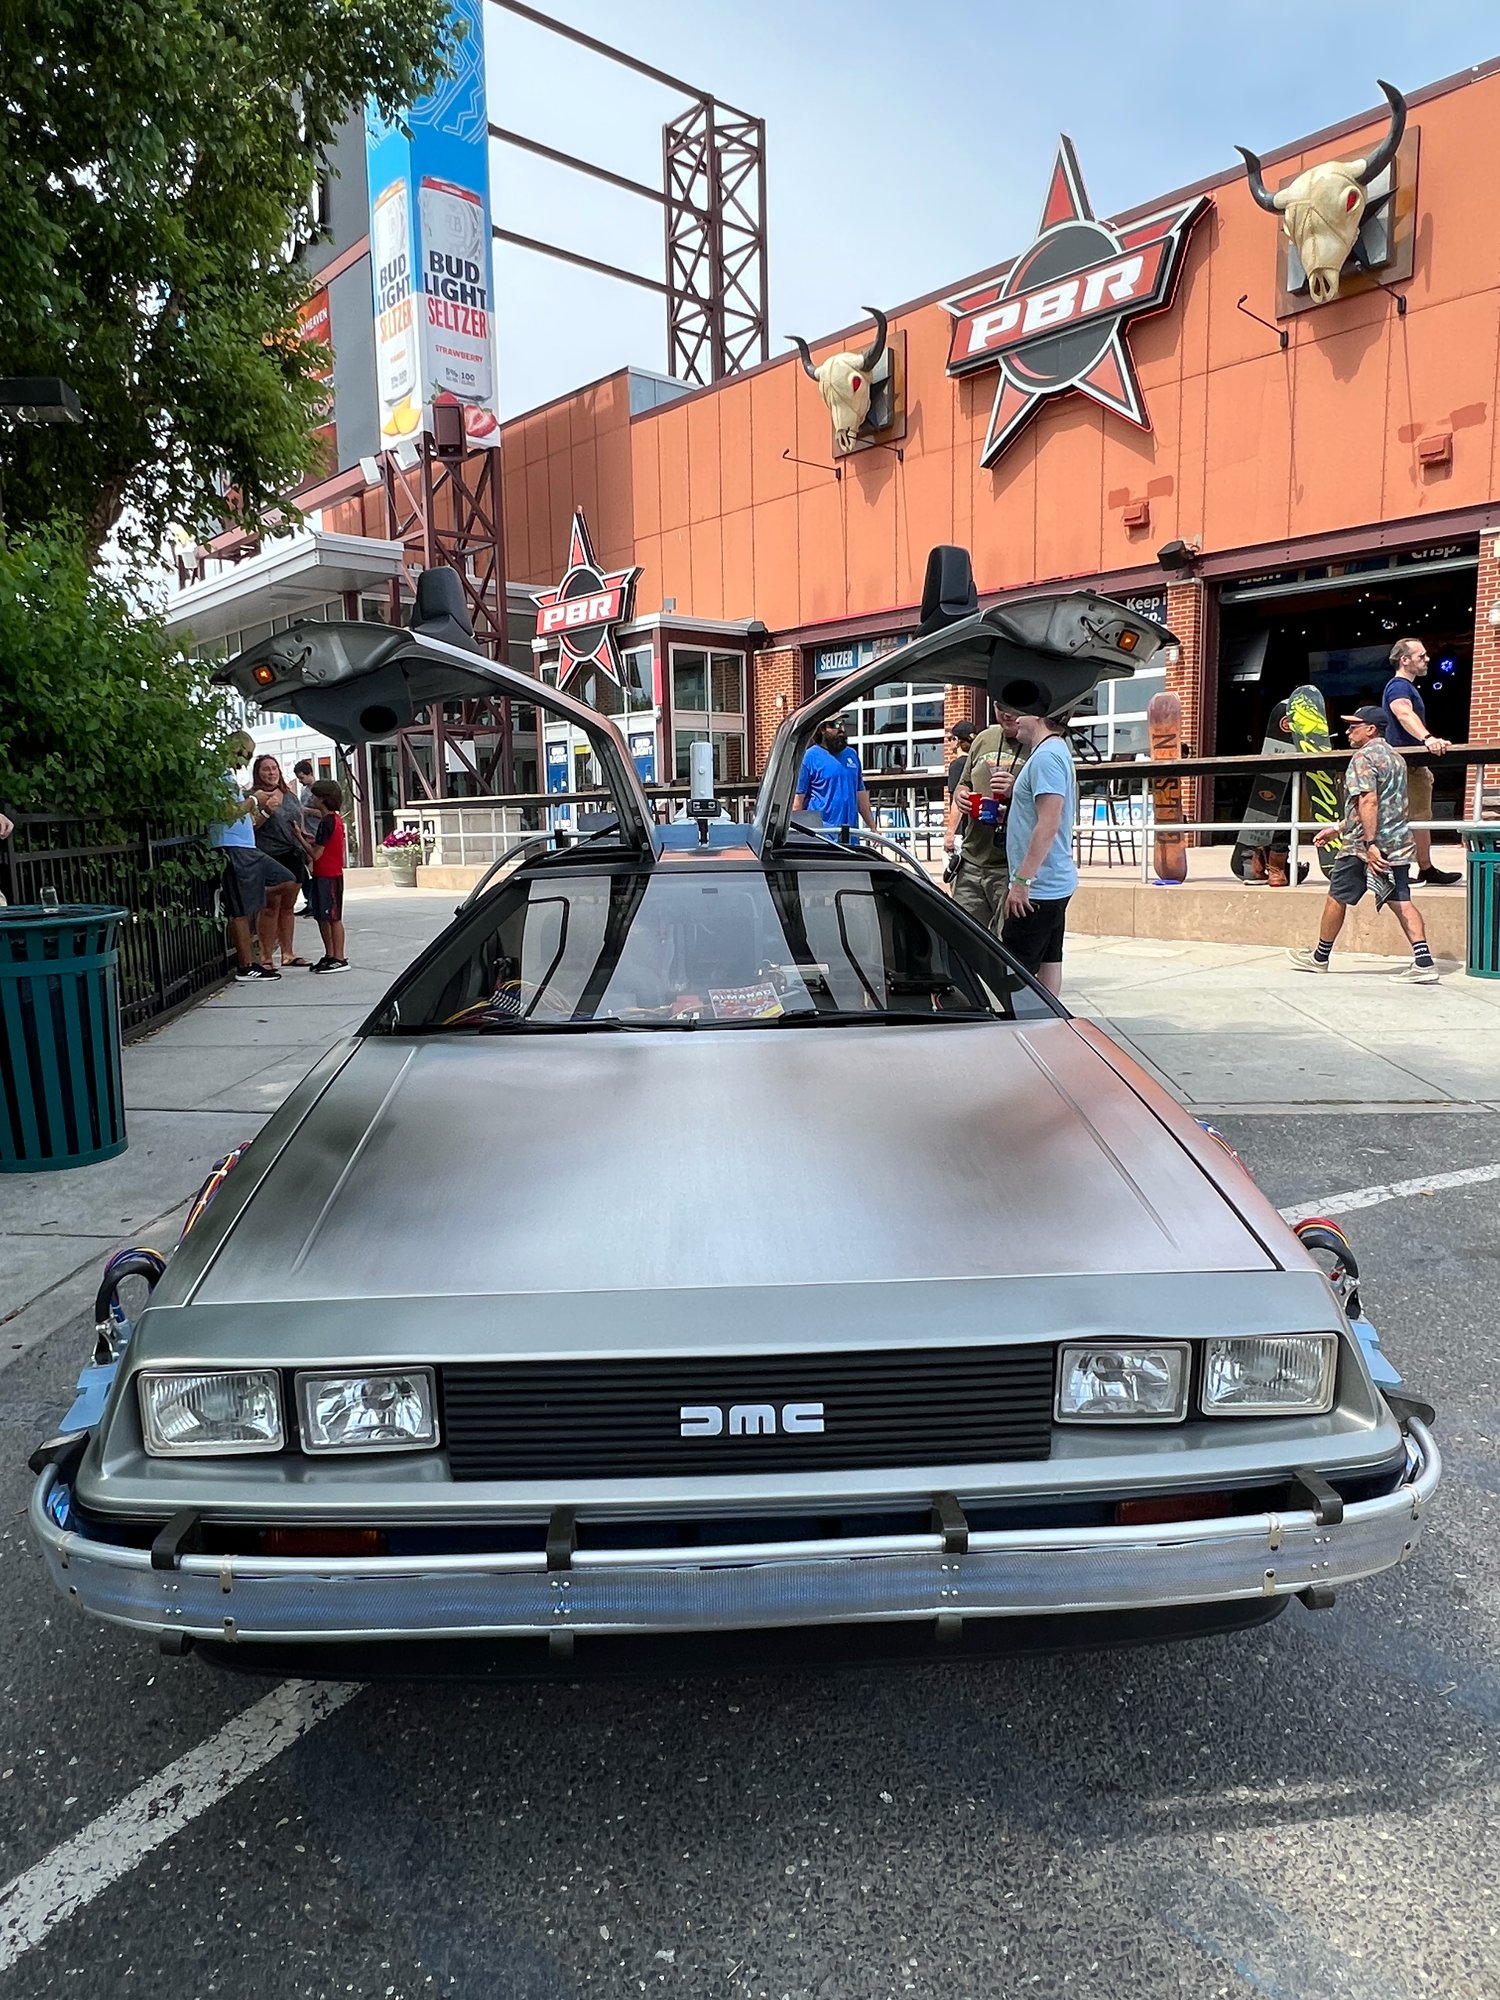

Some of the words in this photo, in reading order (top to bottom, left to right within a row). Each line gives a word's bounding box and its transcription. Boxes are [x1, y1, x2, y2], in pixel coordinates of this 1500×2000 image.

[380, 253, 406, 291] BUD
[429, 250, 480, 284] BUD
[378, 273, 411, 315] LIGHT
[424, 272, 487, 310] LIGHT
[967, 256, 1144, 353] PBR
[380, 299, 412, 344] SELTZER
[427, 297, 487, 340] SELTZER
[435, 344, 483, 363] STRAWBERRY
[543, 594, 613, 632] PBR
[1126, 596, 1160, 610] Keep
[820, 650, 853, 671] SELTZER
[680, 1402, 825, 1436] DMC
